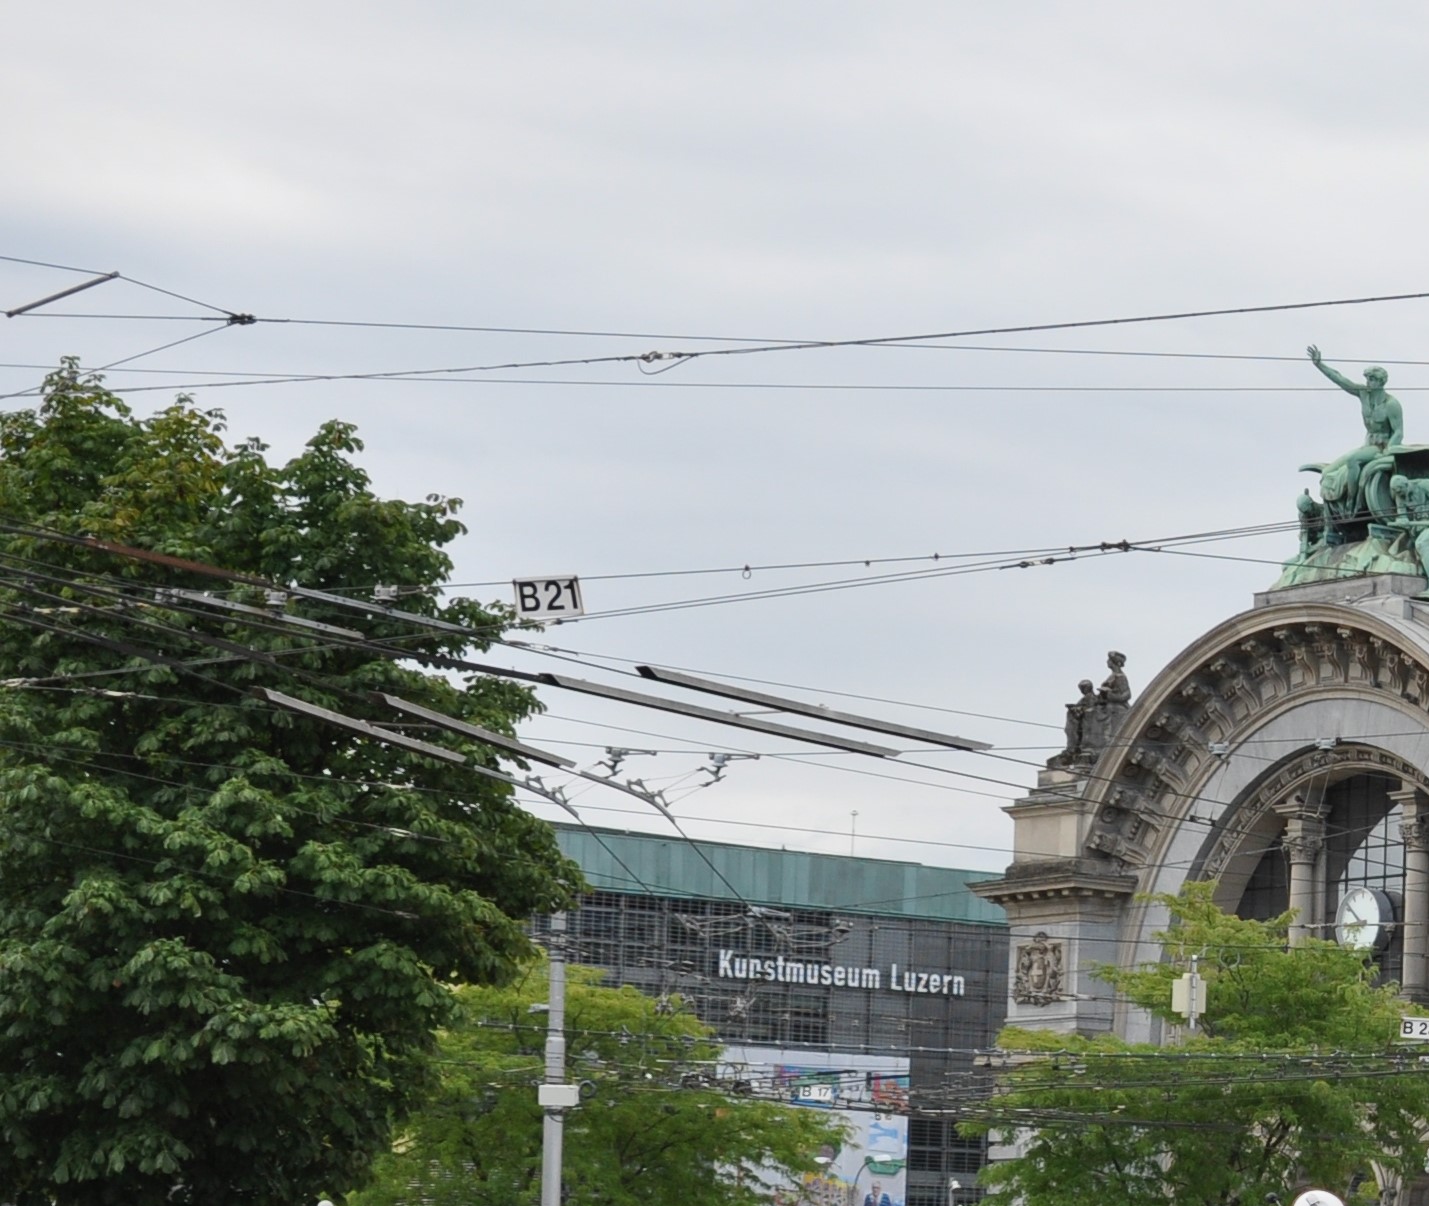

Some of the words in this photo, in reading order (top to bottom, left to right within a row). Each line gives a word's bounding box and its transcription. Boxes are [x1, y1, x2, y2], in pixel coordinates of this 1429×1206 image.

[718, 949, 881, 989] Kunstmuseum
[890, 963, 965, 996] Luzern
[1403, 1021, 1413, 1035] B
[802, 1085, 811, 1097] B
[818, 1087, 830, 1097] 17
